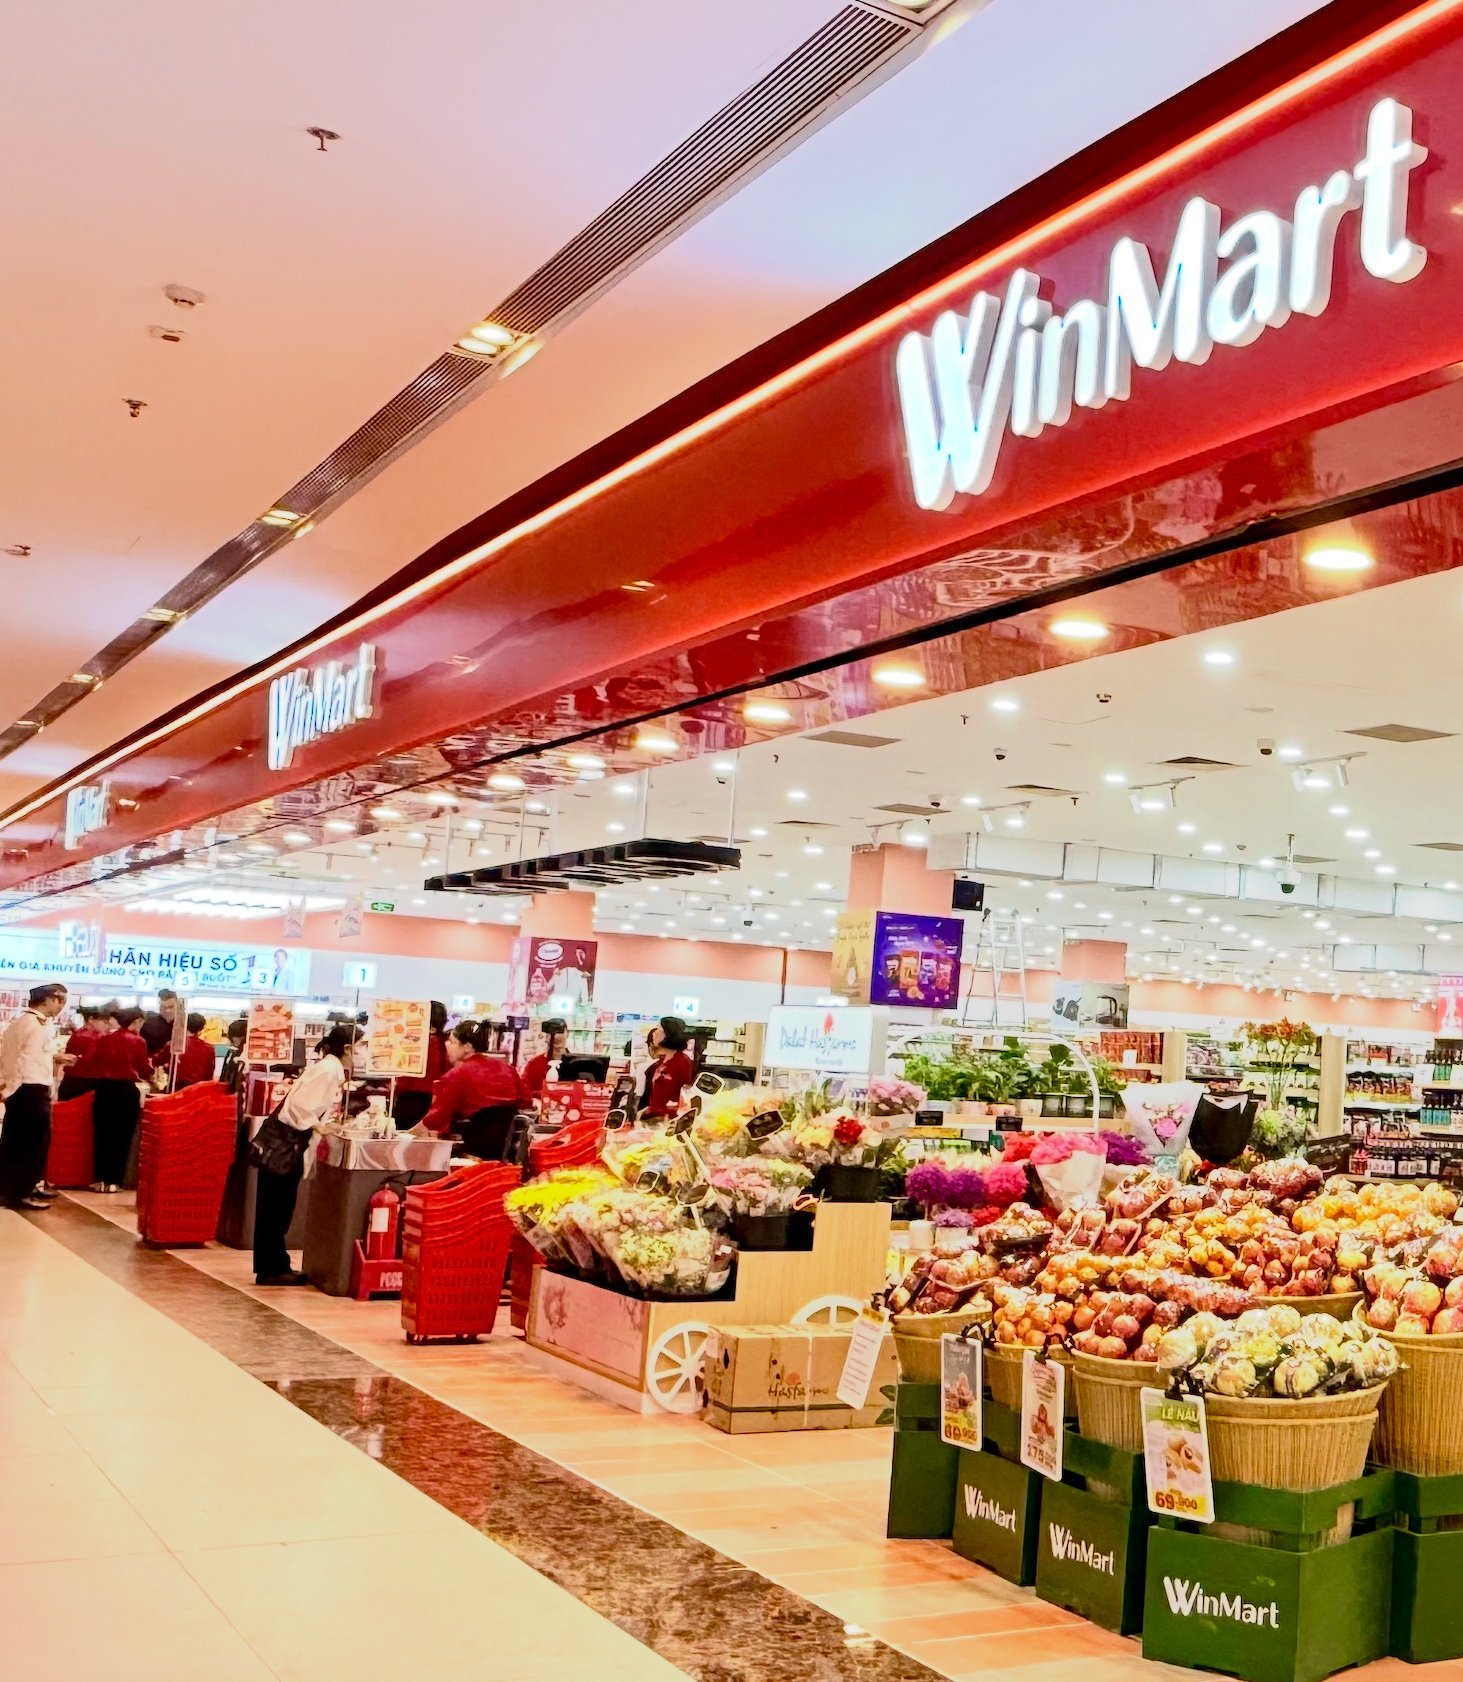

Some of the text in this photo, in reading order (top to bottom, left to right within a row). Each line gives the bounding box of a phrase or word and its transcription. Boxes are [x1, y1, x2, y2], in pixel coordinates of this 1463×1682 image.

[896, 97, 1429, 512] WinMart
[268, 642, 377, 771] WinMart
[964, 1483, 1016, 1533] WinMart
[1049, 1522, 1115, 1576] WinMart
[1163, 1576, 1280, 1629] WinMart
